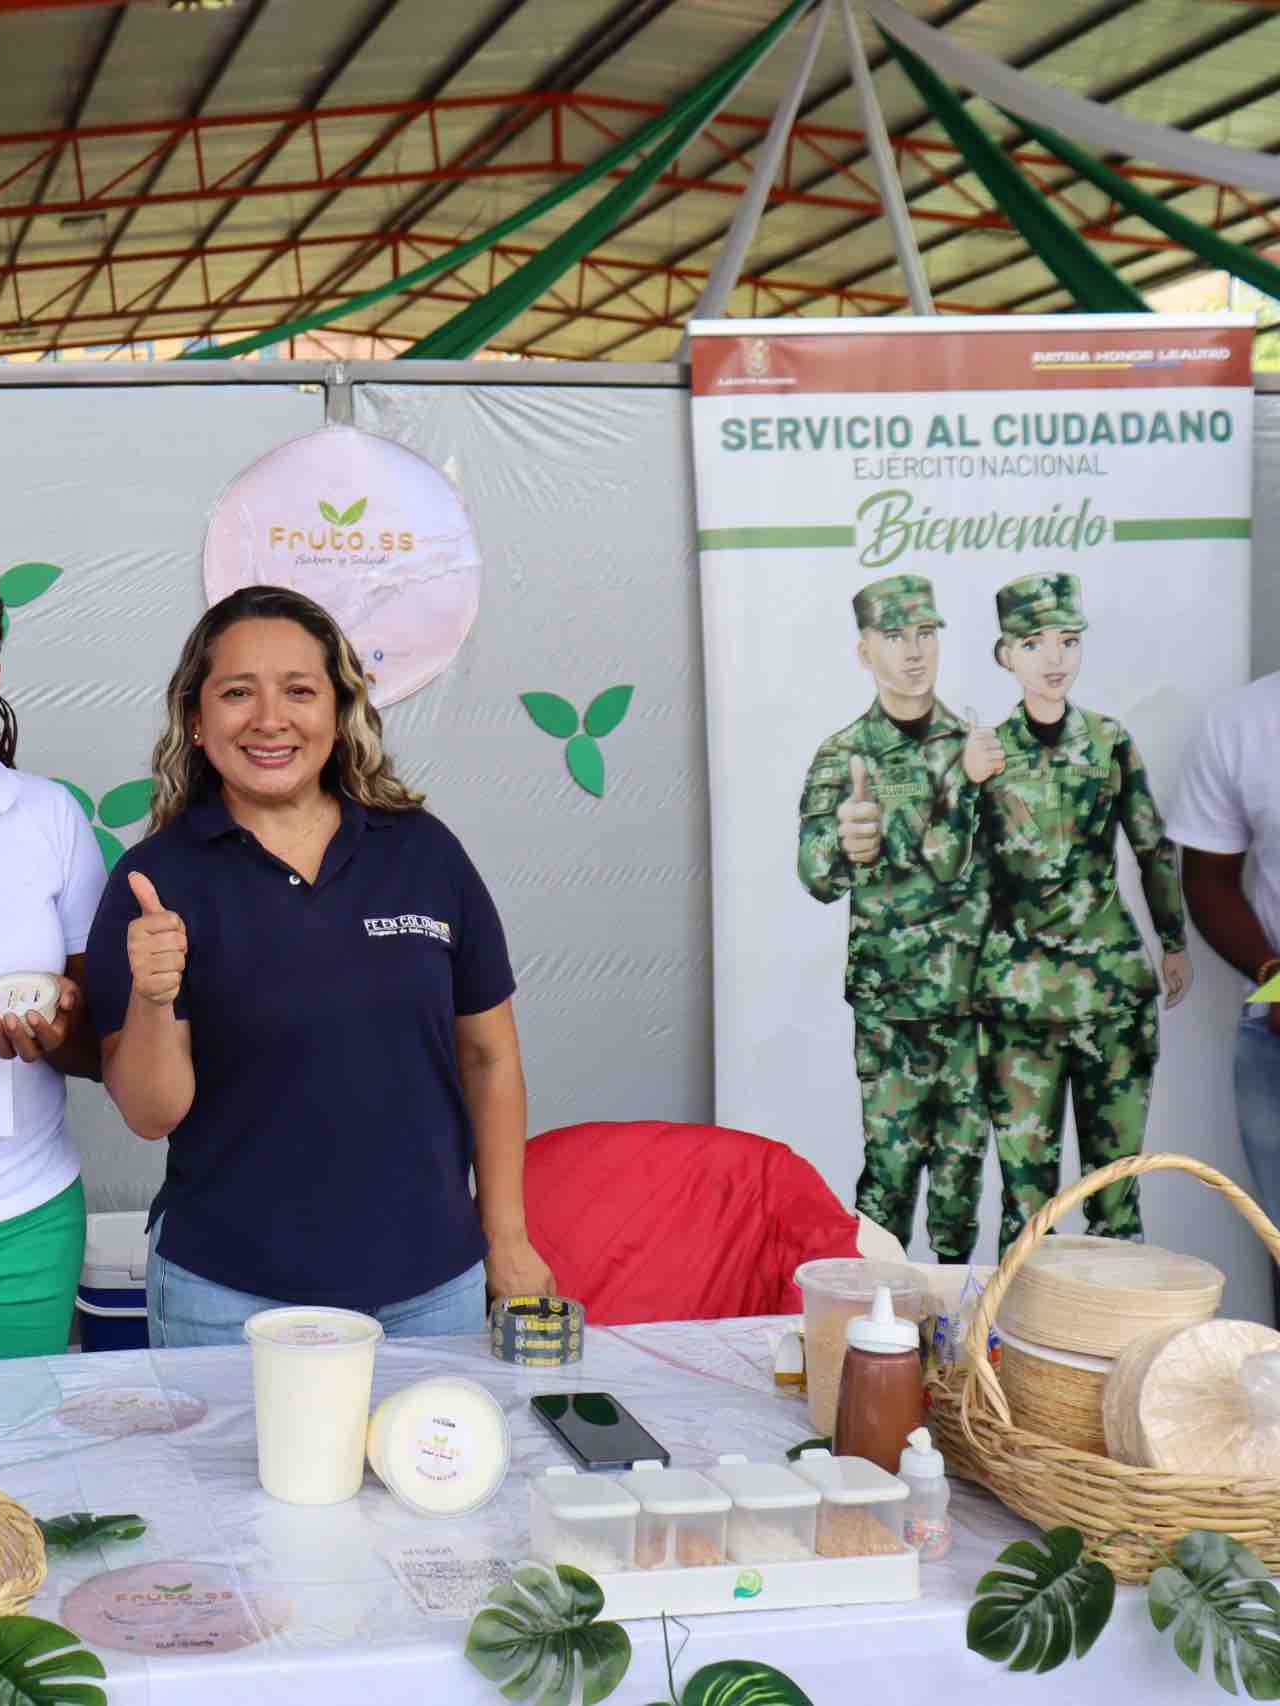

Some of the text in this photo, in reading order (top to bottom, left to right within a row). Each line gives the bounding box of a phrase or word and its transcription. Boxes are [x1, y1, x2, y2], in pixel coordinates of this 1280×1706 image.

[720, 410, 1234, 451] SERVICIO AL CIUDADANO
[980, 452, 1109, 479] NACIONAL
[270, 527, 417, 551] Fruto.ss
[856, 488, 1109, 568] Bienvenido
